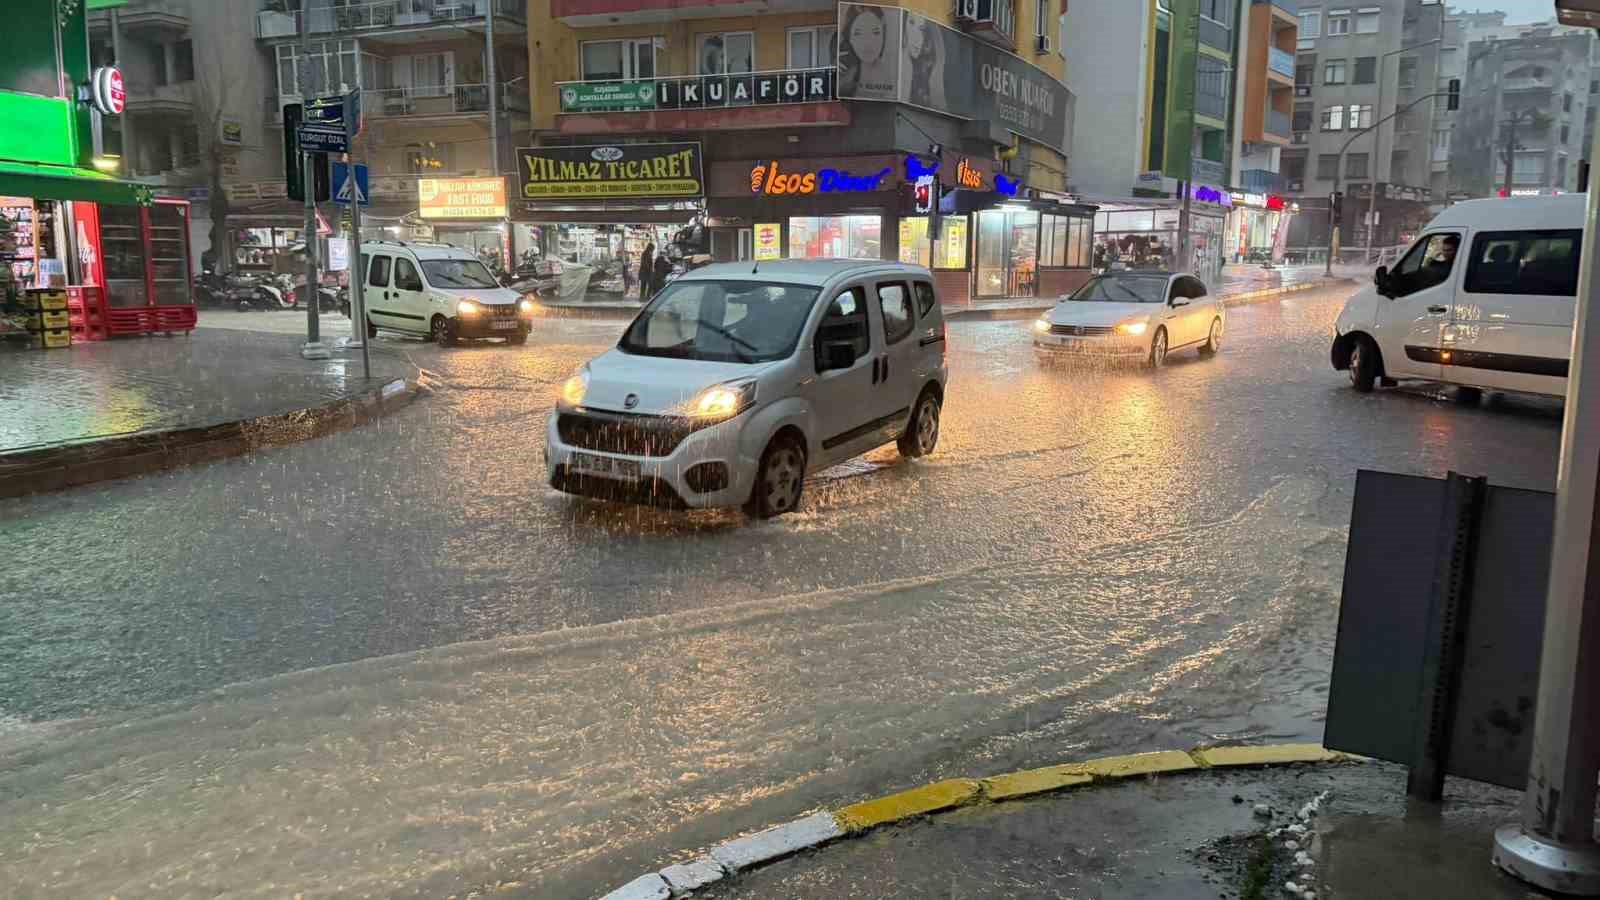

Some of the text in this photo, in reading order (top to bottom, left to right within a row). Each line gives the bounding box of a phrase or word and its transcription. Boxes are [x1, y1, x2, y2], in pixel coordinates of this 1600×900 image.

[981, 63, 1018, 99] OBEN
[300, 132, 346, 145] TURGUT ÖZAL
[524, 154, 601, 181] YILMAZ
